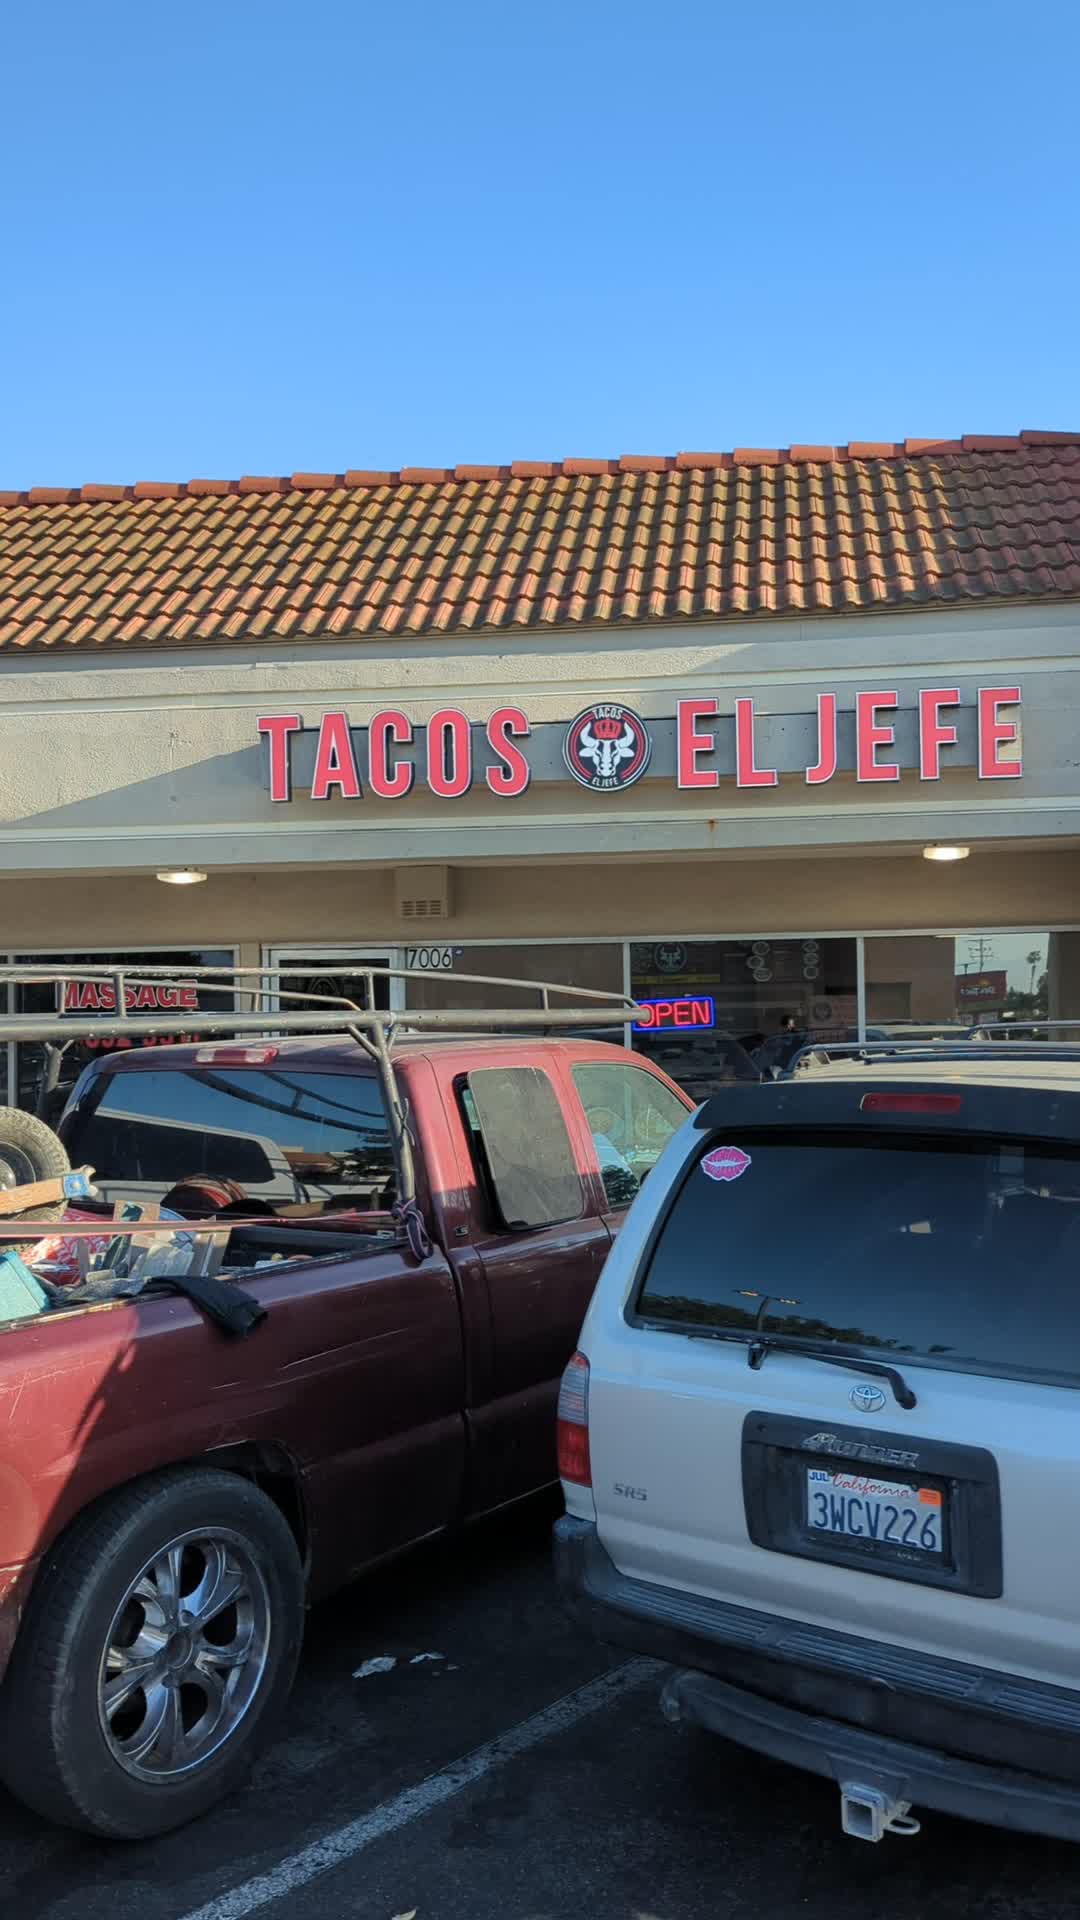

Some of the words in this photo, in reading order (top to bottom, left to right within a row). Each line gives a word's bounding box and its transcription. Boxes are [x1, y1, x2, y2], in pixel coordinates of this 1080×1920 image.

[592, 707, 623, 720] TACOS
[256, 706, 531, 802] TACOS
[676, 697, 779, 789] EL
[805, 686, 1023, 785] JEFE
[602, 776, 619, 787] JEFE
[408, 948, 452, 968] 7006
[809, 1471, 829, 1481] JUL
[832, 1472, 911, 1498] California
[813, 1492, 937, 1550] 3WCV226
